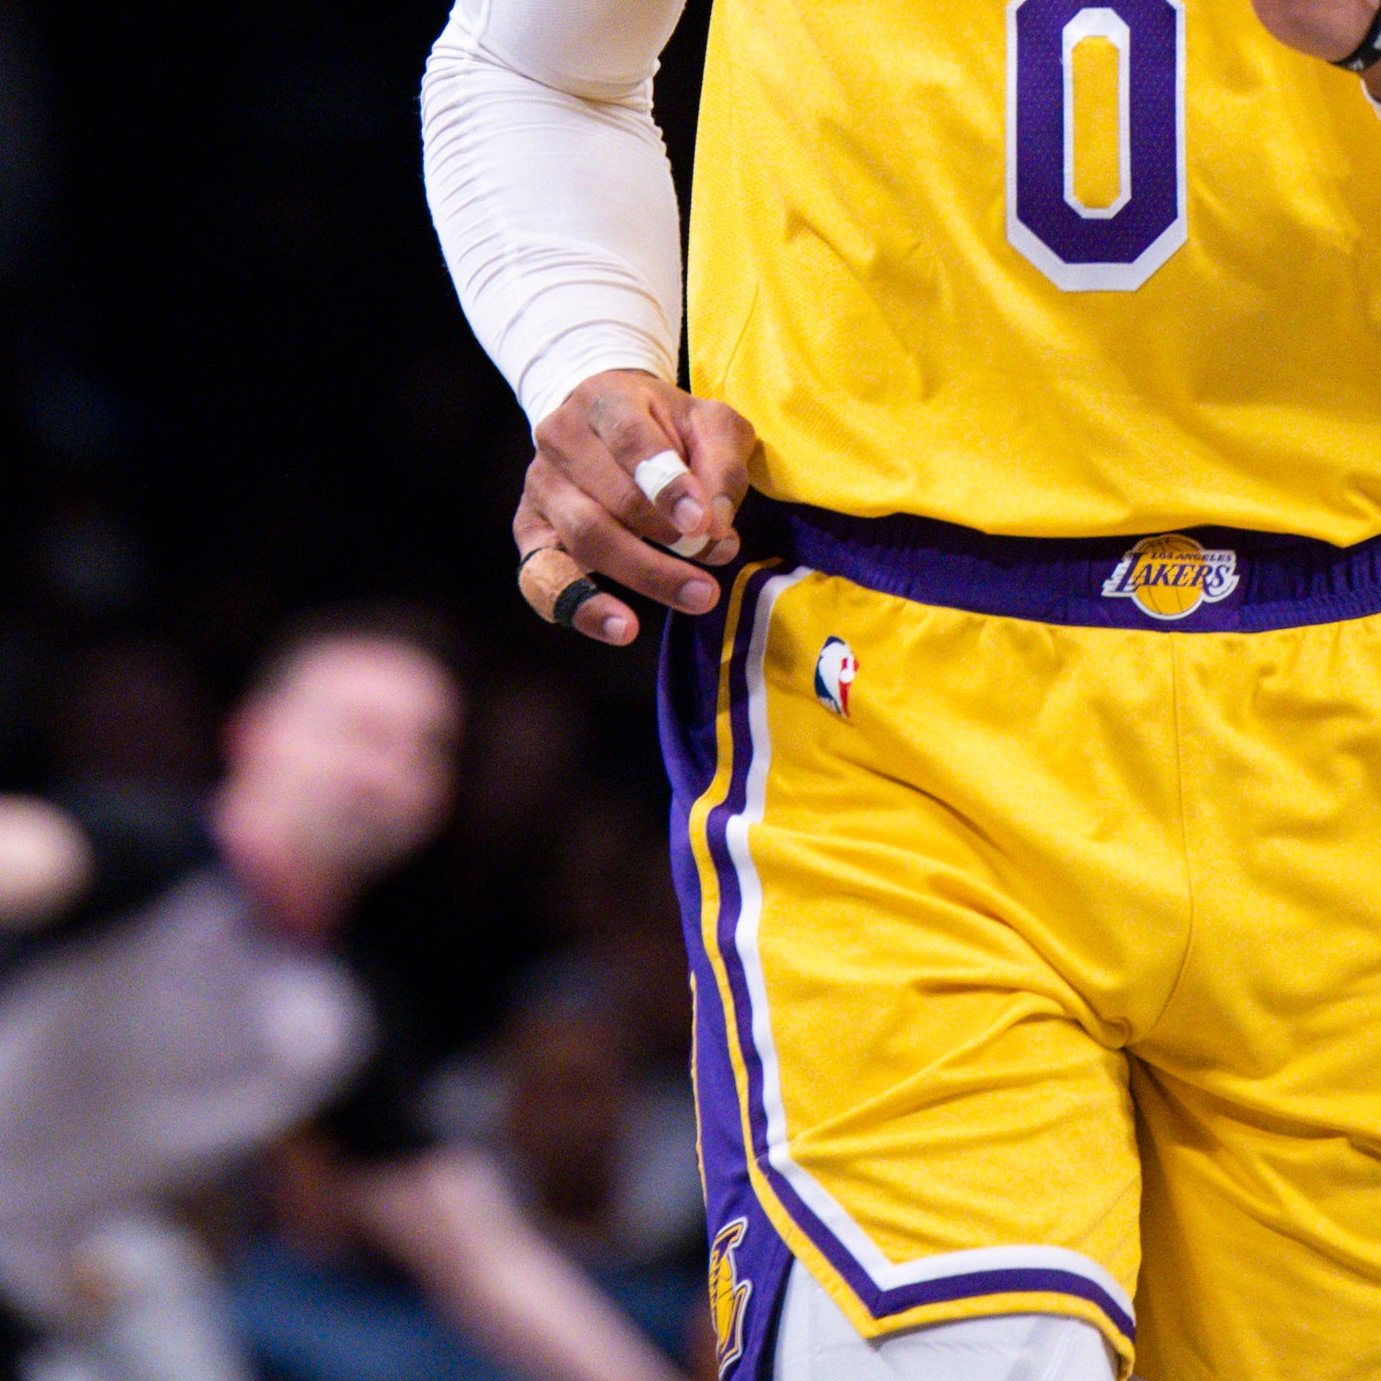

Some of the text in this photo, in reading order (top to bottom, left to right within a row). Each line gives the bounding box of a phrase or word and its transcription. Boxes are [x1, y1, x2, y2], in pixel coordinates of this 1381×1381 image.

[1150, 552, 1233, 563] LOS ANGELES
[1104, 551, 1237, 600] LAKERS
